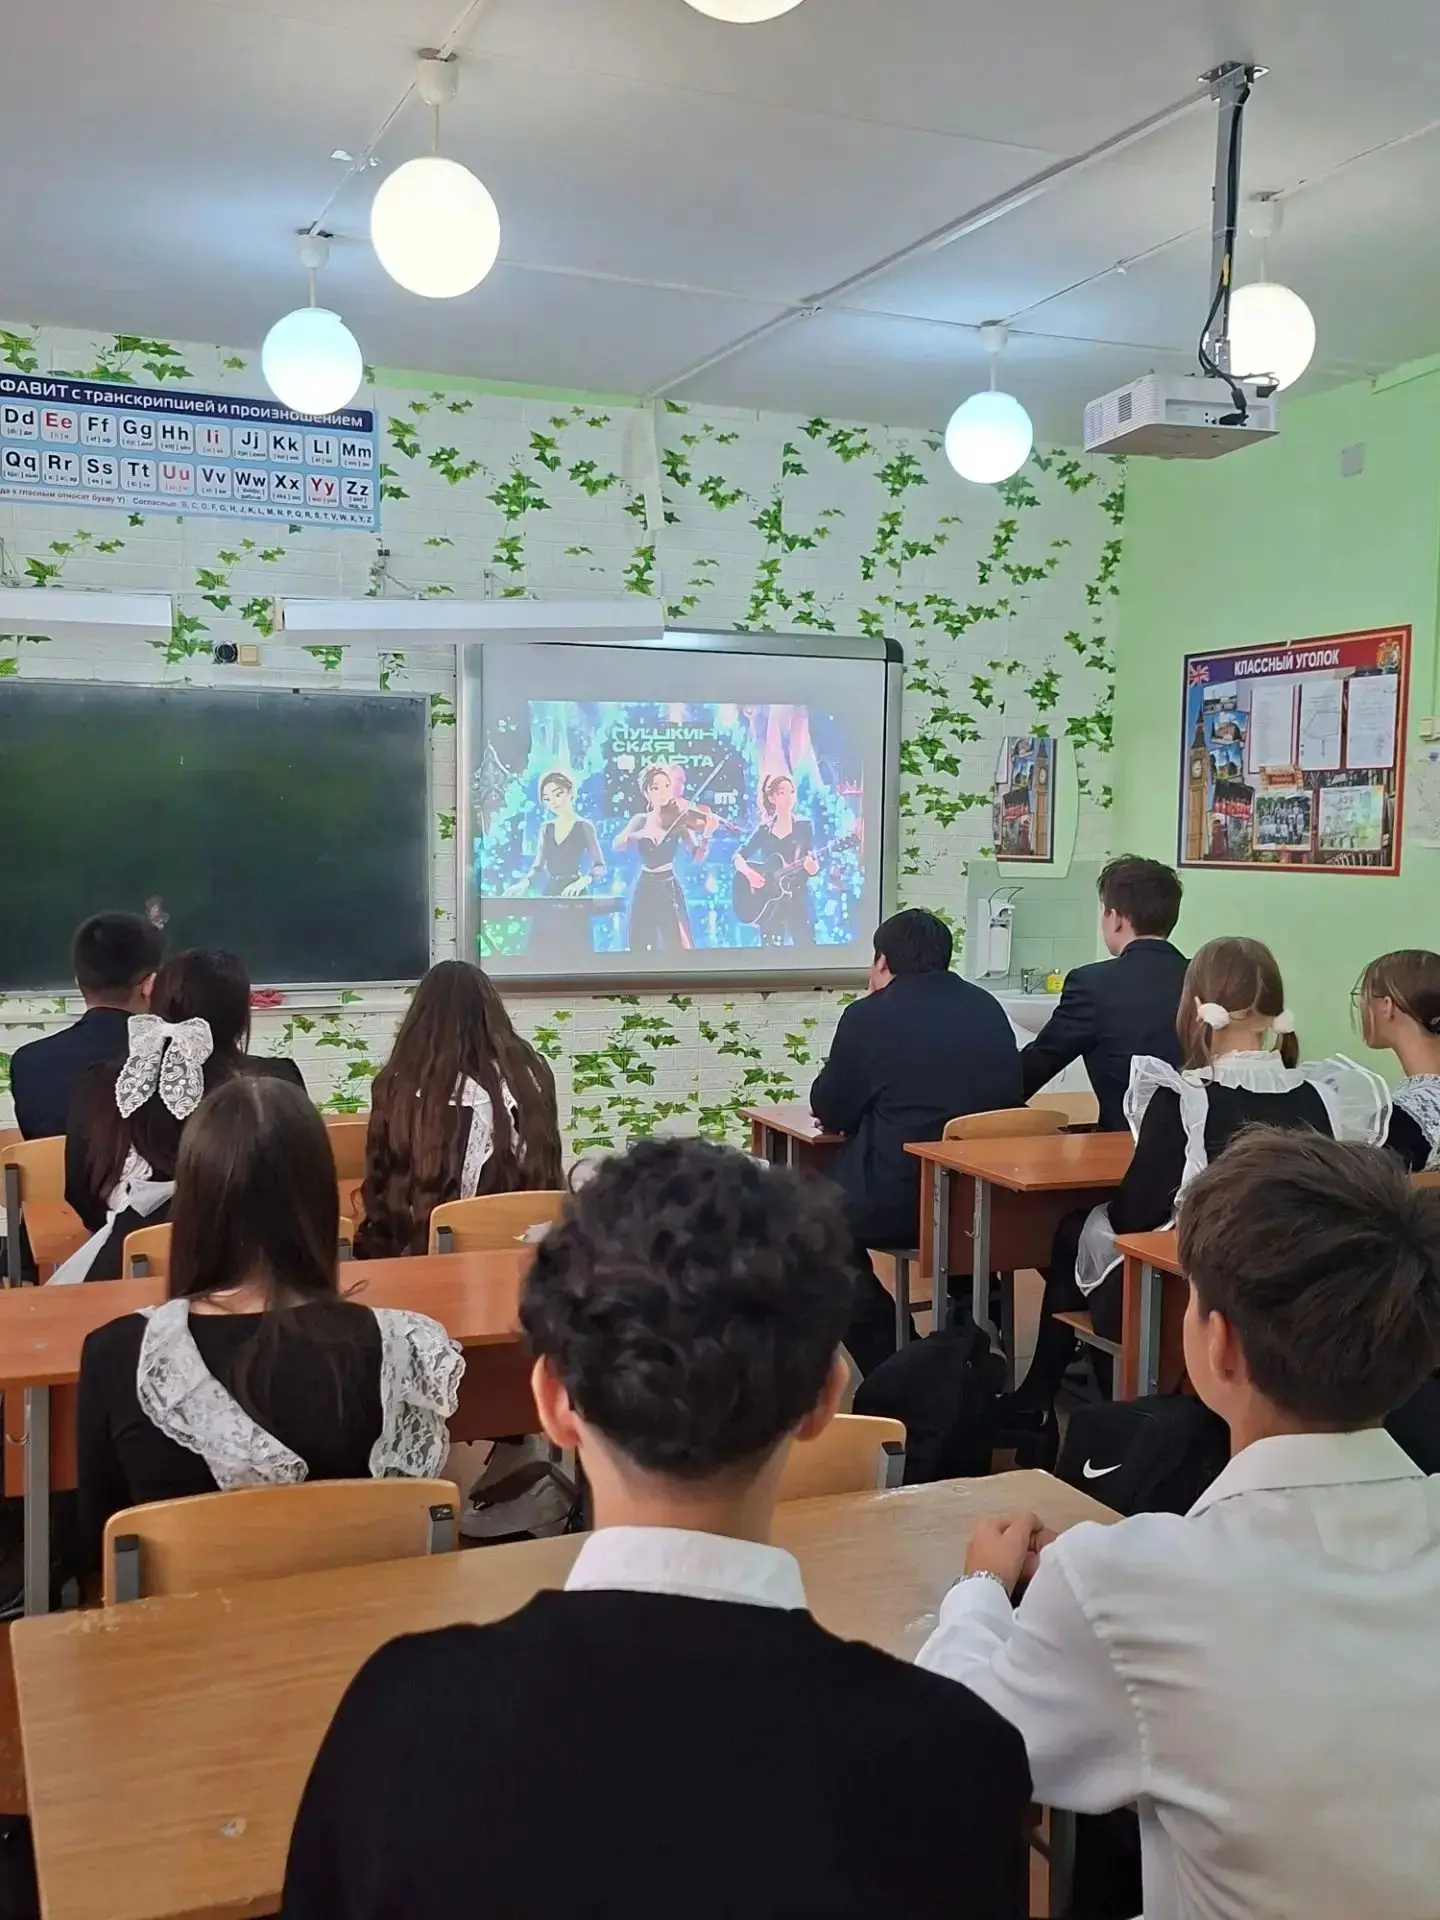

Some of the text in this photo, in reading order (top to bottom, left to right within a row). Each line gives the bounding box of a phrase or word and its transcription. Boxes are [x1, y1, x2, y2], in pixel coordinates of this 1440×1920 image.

[0, 379, 363, 428] ФАВИТ с транскрипцией и произношением
[1234, 649, 1340, 676] КЛАССНЫЙ УГОЛОК
[612, 741, 675, 753] СКАЯ
[641, 755, 715, 768] КАРТА
